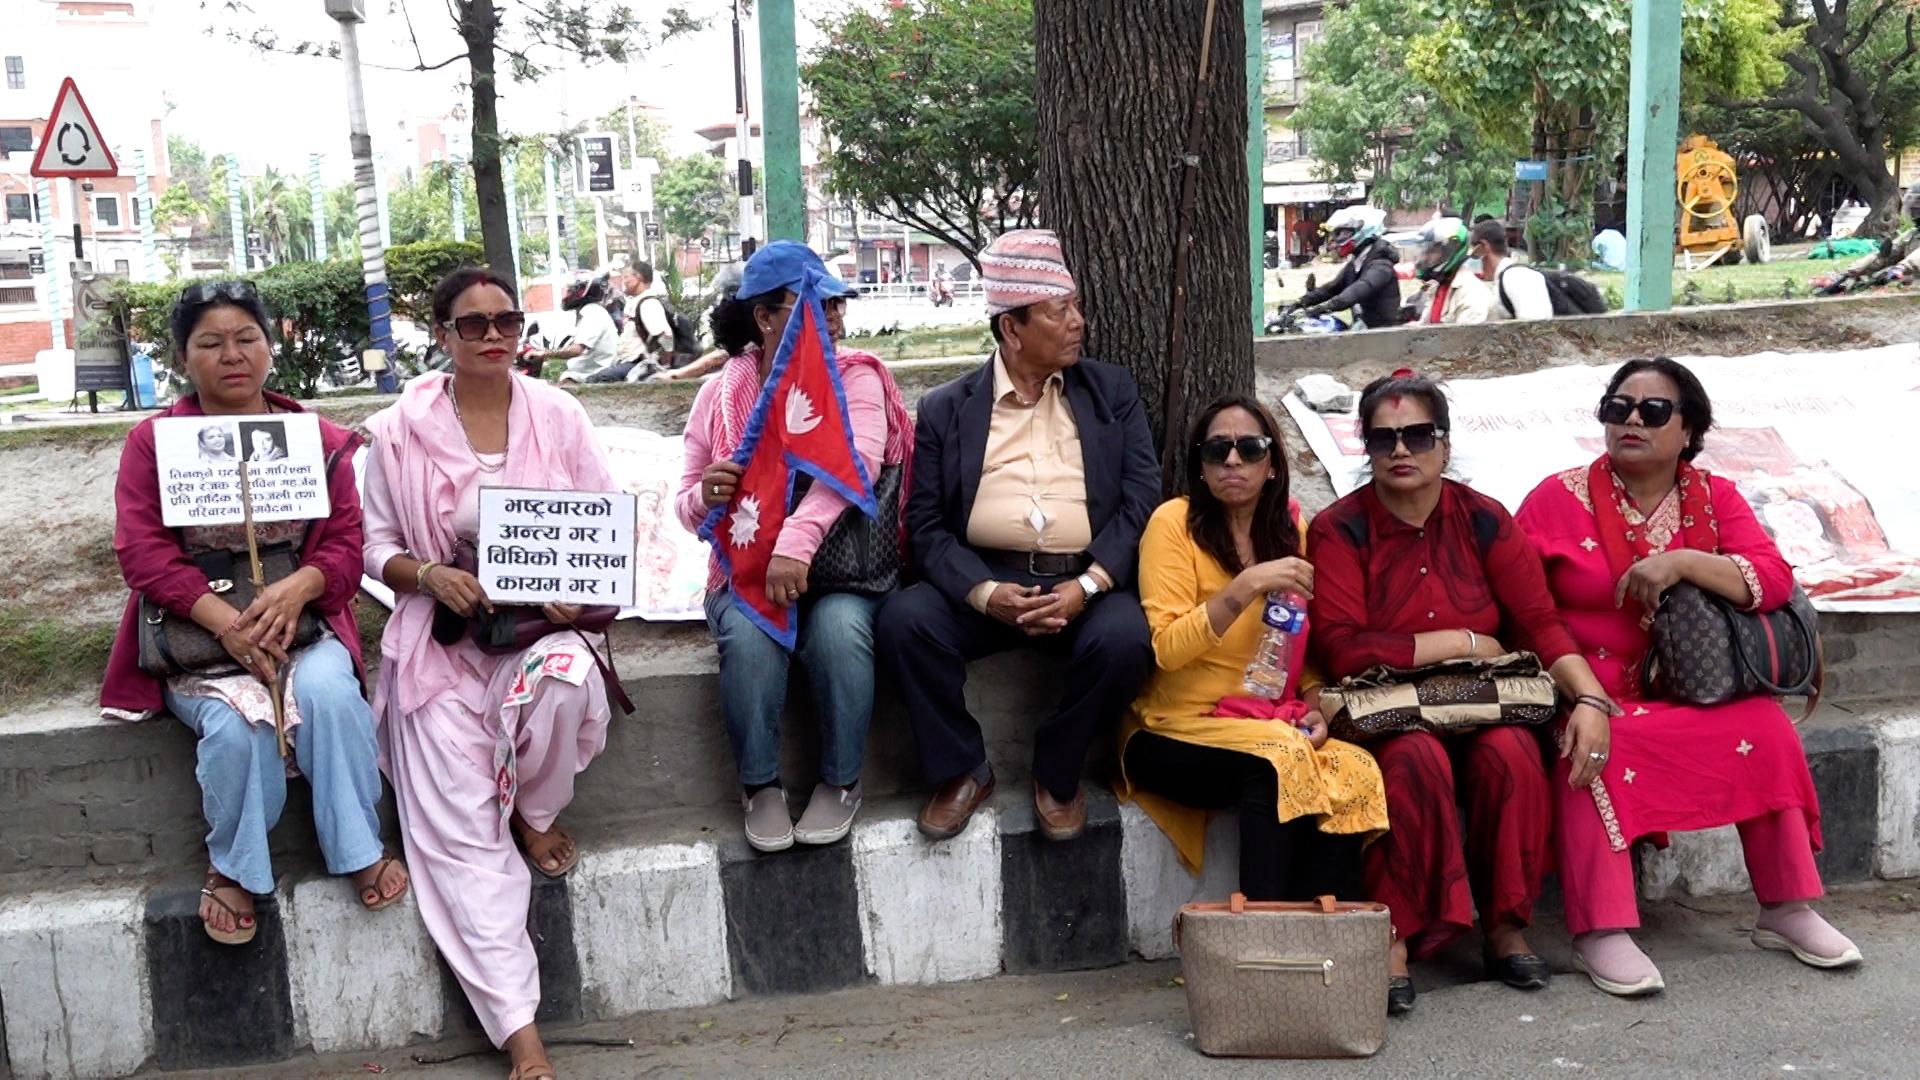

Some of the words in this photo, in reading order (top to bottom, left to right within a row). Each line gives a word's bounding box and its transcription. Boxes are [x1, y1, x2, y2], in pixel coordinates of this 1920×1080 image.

[499, 524, 561, 541] अन्त्य
[568, 527, 601, 543] गर
[487, 545, 559, 566] विधिको
[566, 552, 628, 569] सासन
[496, 575, 561, 592] कायम
[568, 578, 601, 594] गर
